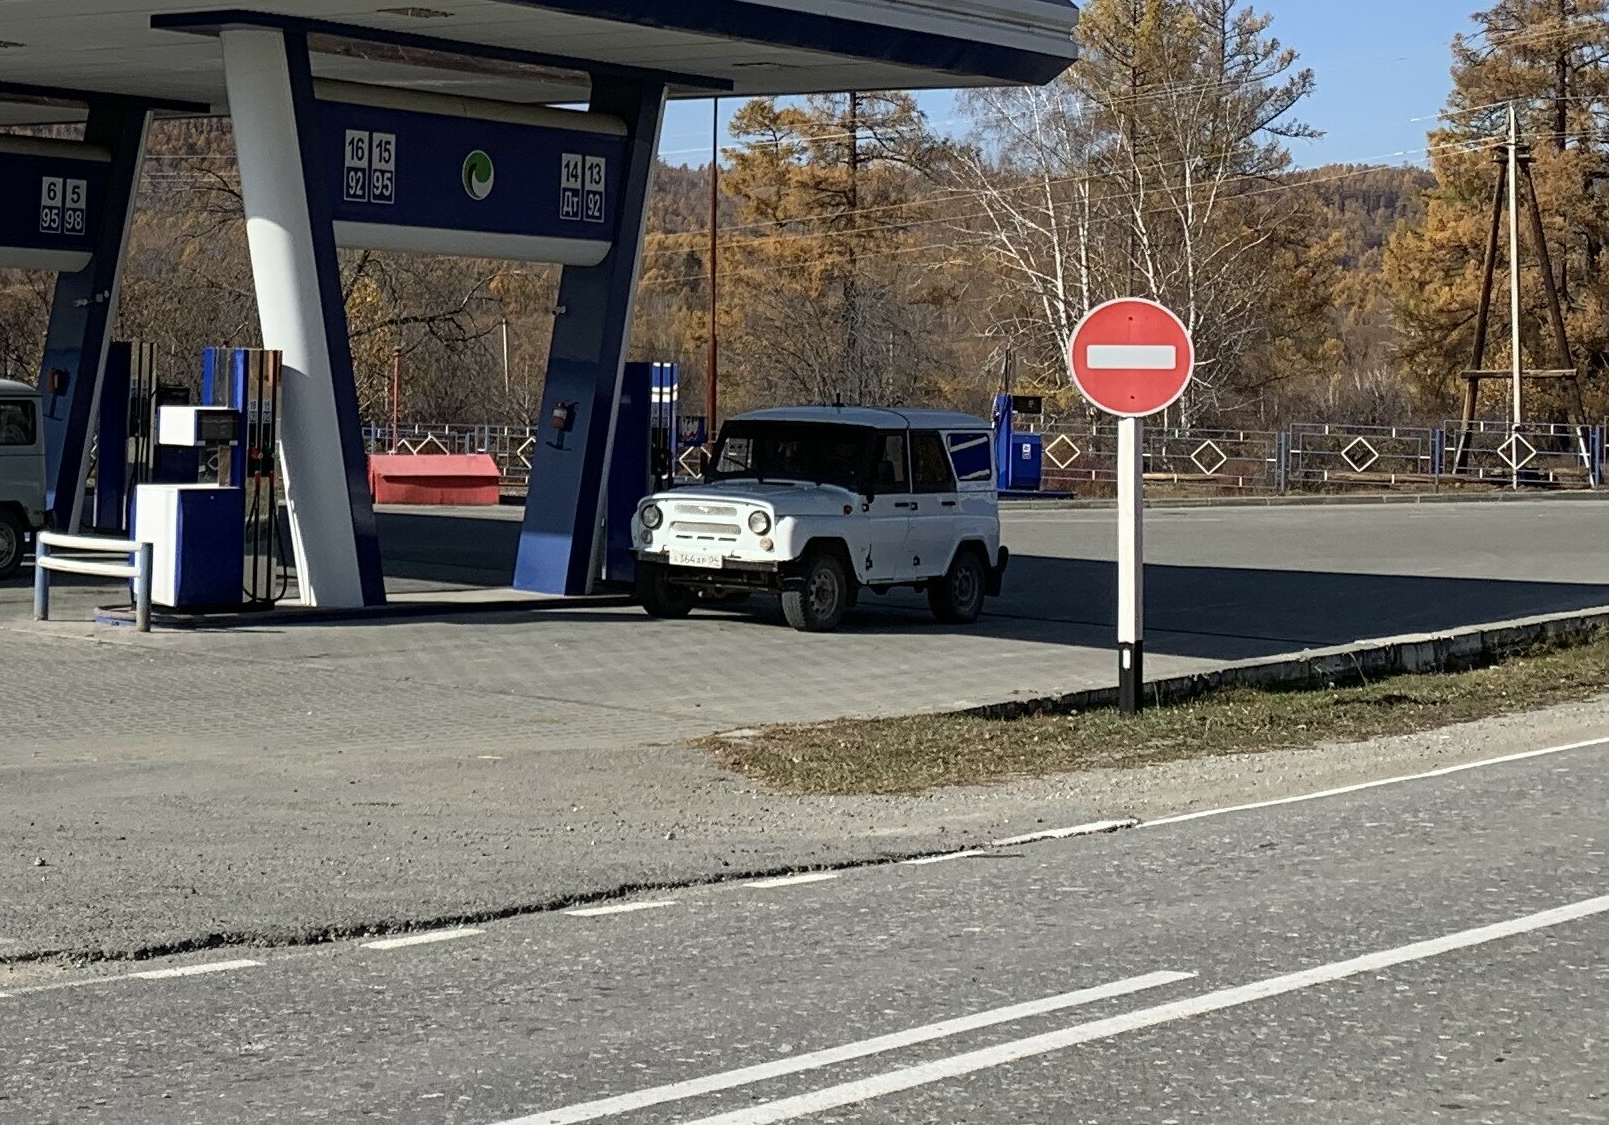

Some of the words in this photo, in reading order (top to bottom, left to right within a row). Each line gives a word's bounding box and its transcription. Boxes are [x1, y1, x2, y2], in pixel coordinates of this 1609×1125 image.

[347, 136, 365, 162] 16
[375, 138, 391, 164] 15
[347, 170, 364, 196] 92
[373, 172, 392, 197] 95
[563, 159, 579, 183] 14
[587, 161, 602, 185] 13
[47, 181, 57, 201] 6
[70, 184, 81, 205] 5
[562, 190, 580, 215] Дт
[586, 193, 601, 217] 92
[41, 208, 60, 227] 95
[64, 210, 83, 229] 98
